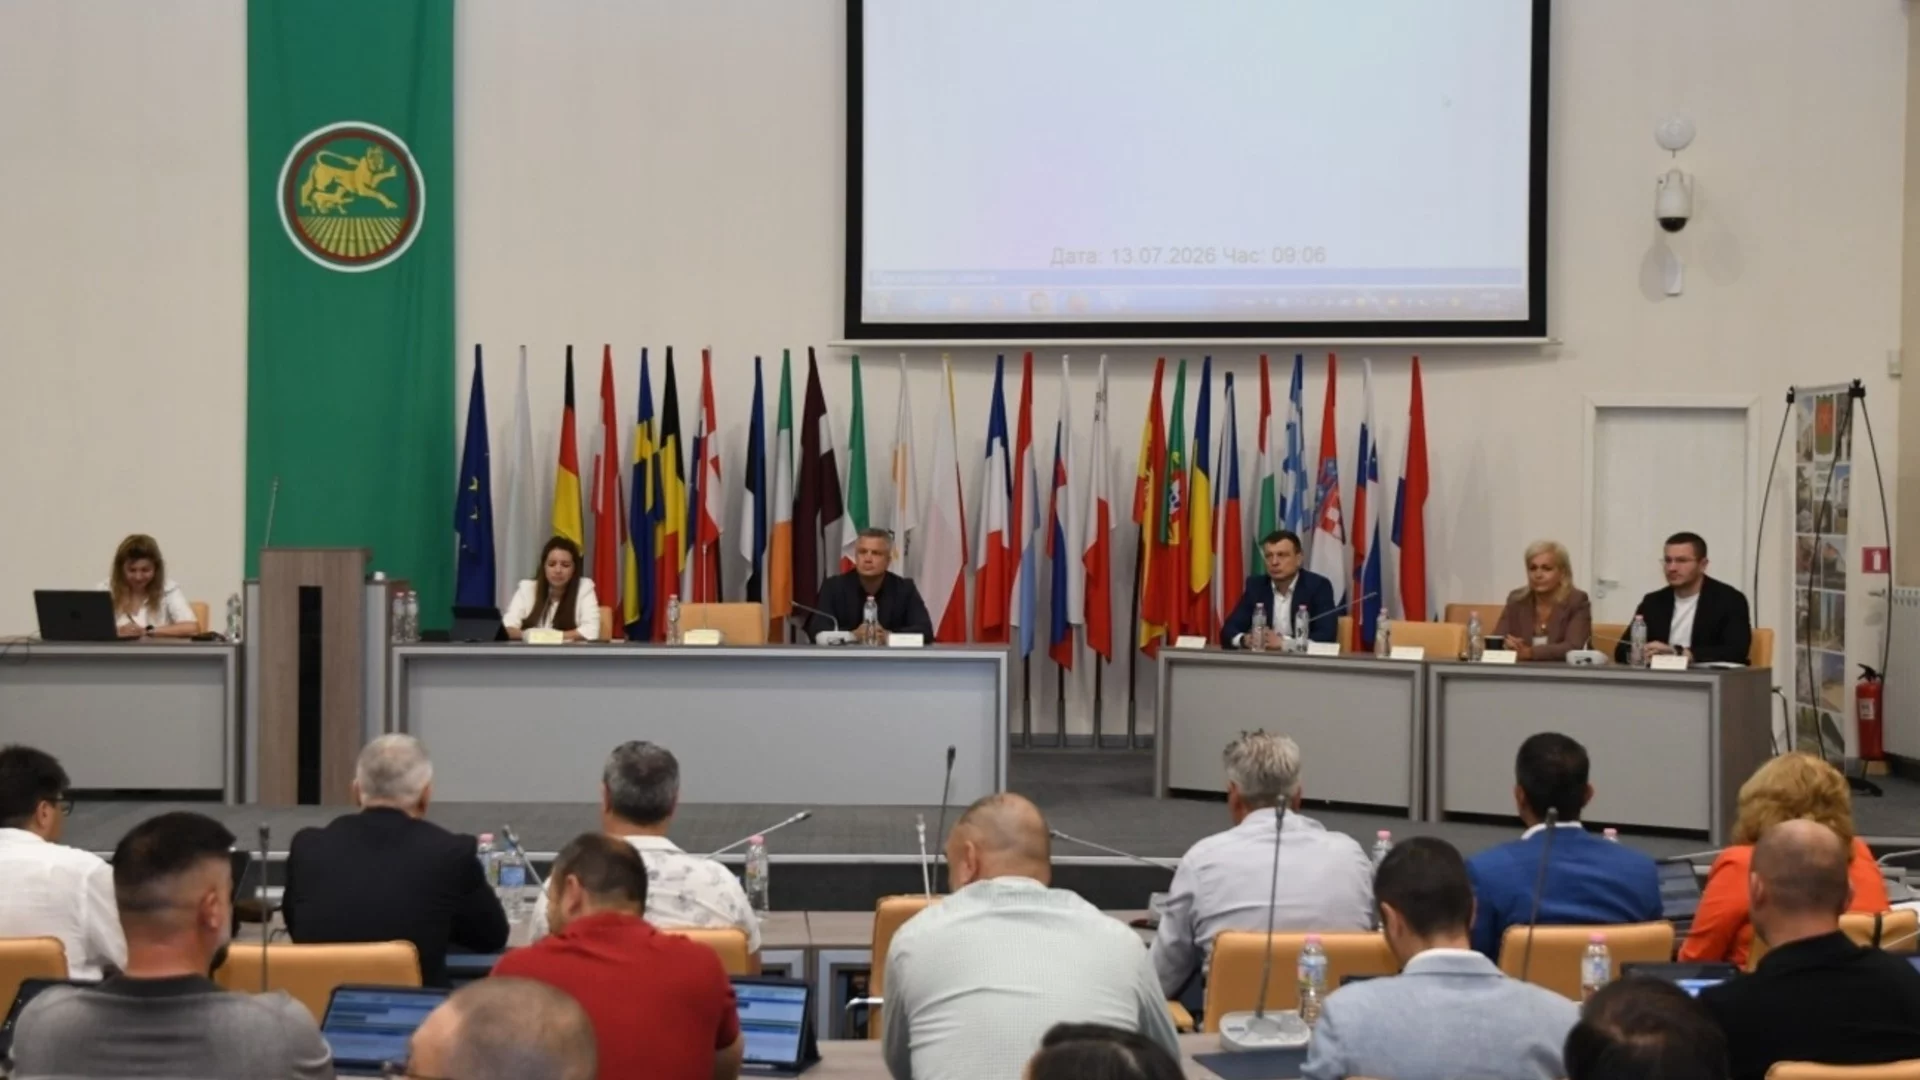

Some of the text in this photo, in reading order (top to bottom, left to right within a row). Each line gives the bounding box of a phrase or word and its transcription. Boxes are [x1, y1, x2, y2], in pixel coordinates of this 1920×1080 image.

[1050, 246, 1102, 267] Дата:
[1111, 246, 1217, 265] 13.07.2026
[1222, 246, 1265, 265] Час:
